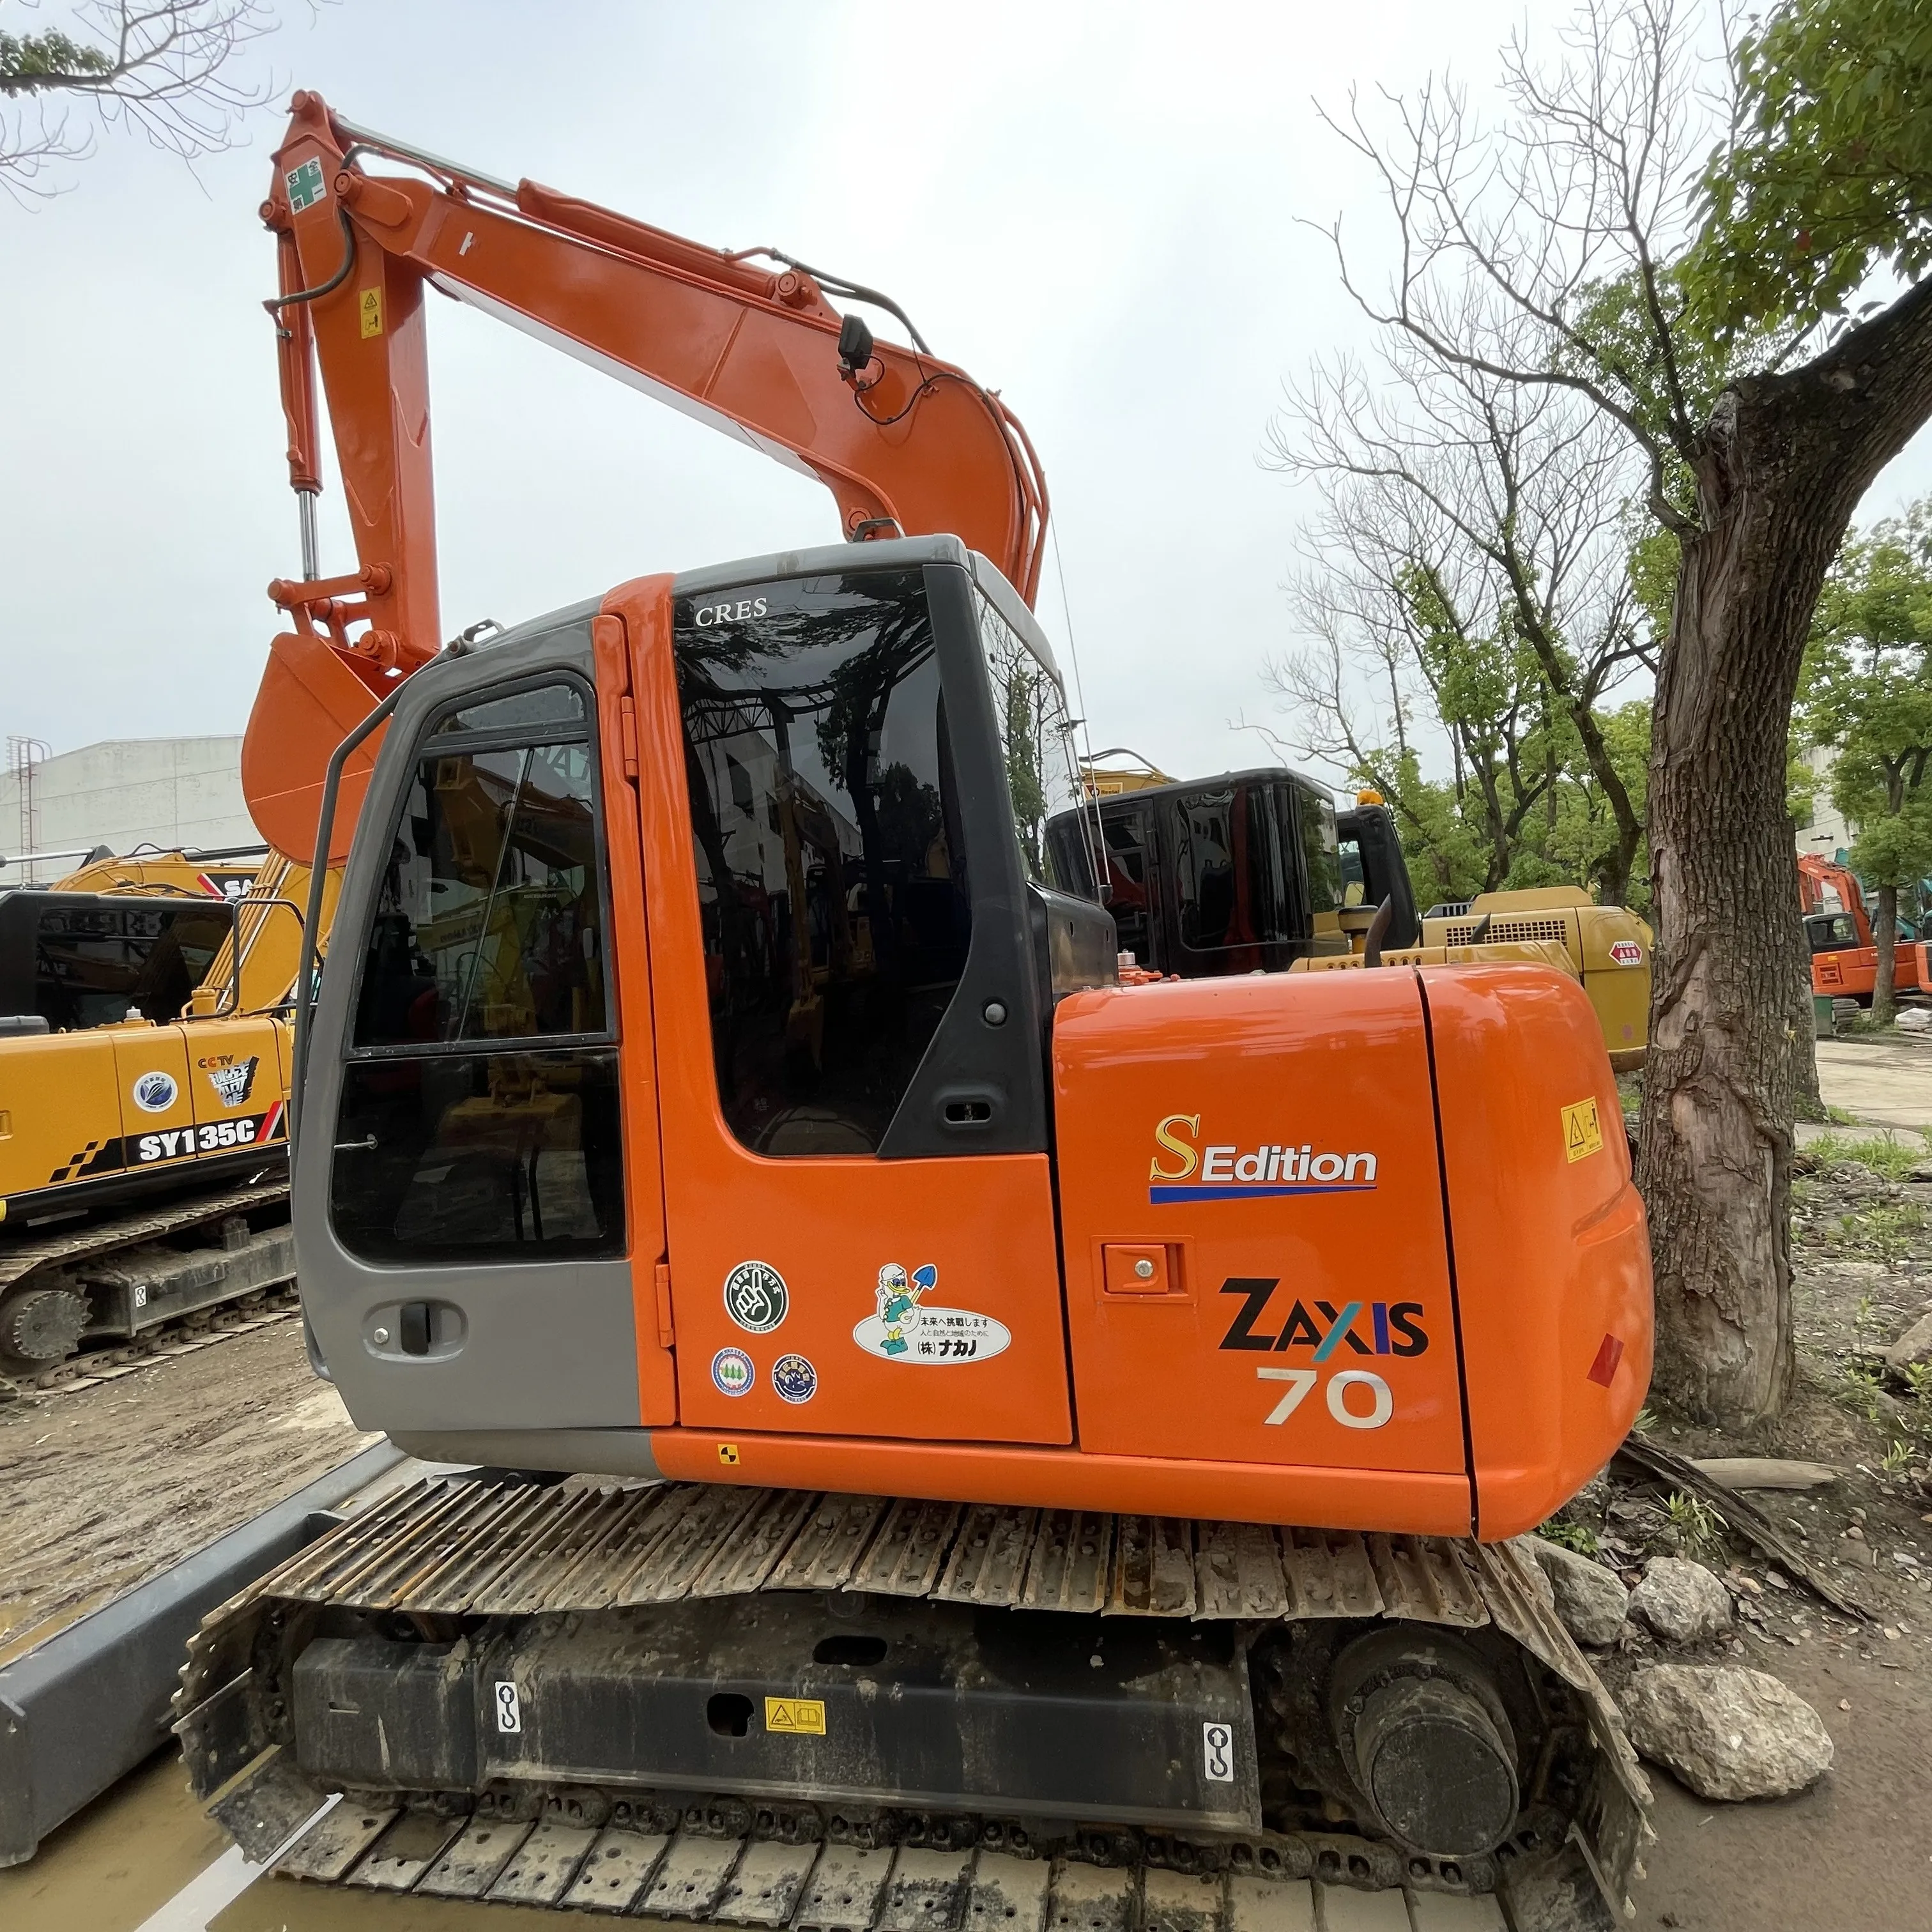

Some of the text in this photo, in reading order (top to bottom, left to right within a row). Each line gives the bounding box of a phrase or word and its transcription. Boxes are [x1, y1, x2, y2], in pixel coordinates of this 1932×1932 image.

[695, 597, 767, 627] CRES
[224, 878, 254, 896] SA
[197, 1054, 234, 1069] CCTV
[139, 1119, 255, 1161] SY135C
[1149, 1114, 1377, 1181] S Edition
[1218, 1277, 1430, 1362] ZAXIS
[1256, 1367, 1394, 1429] 70
